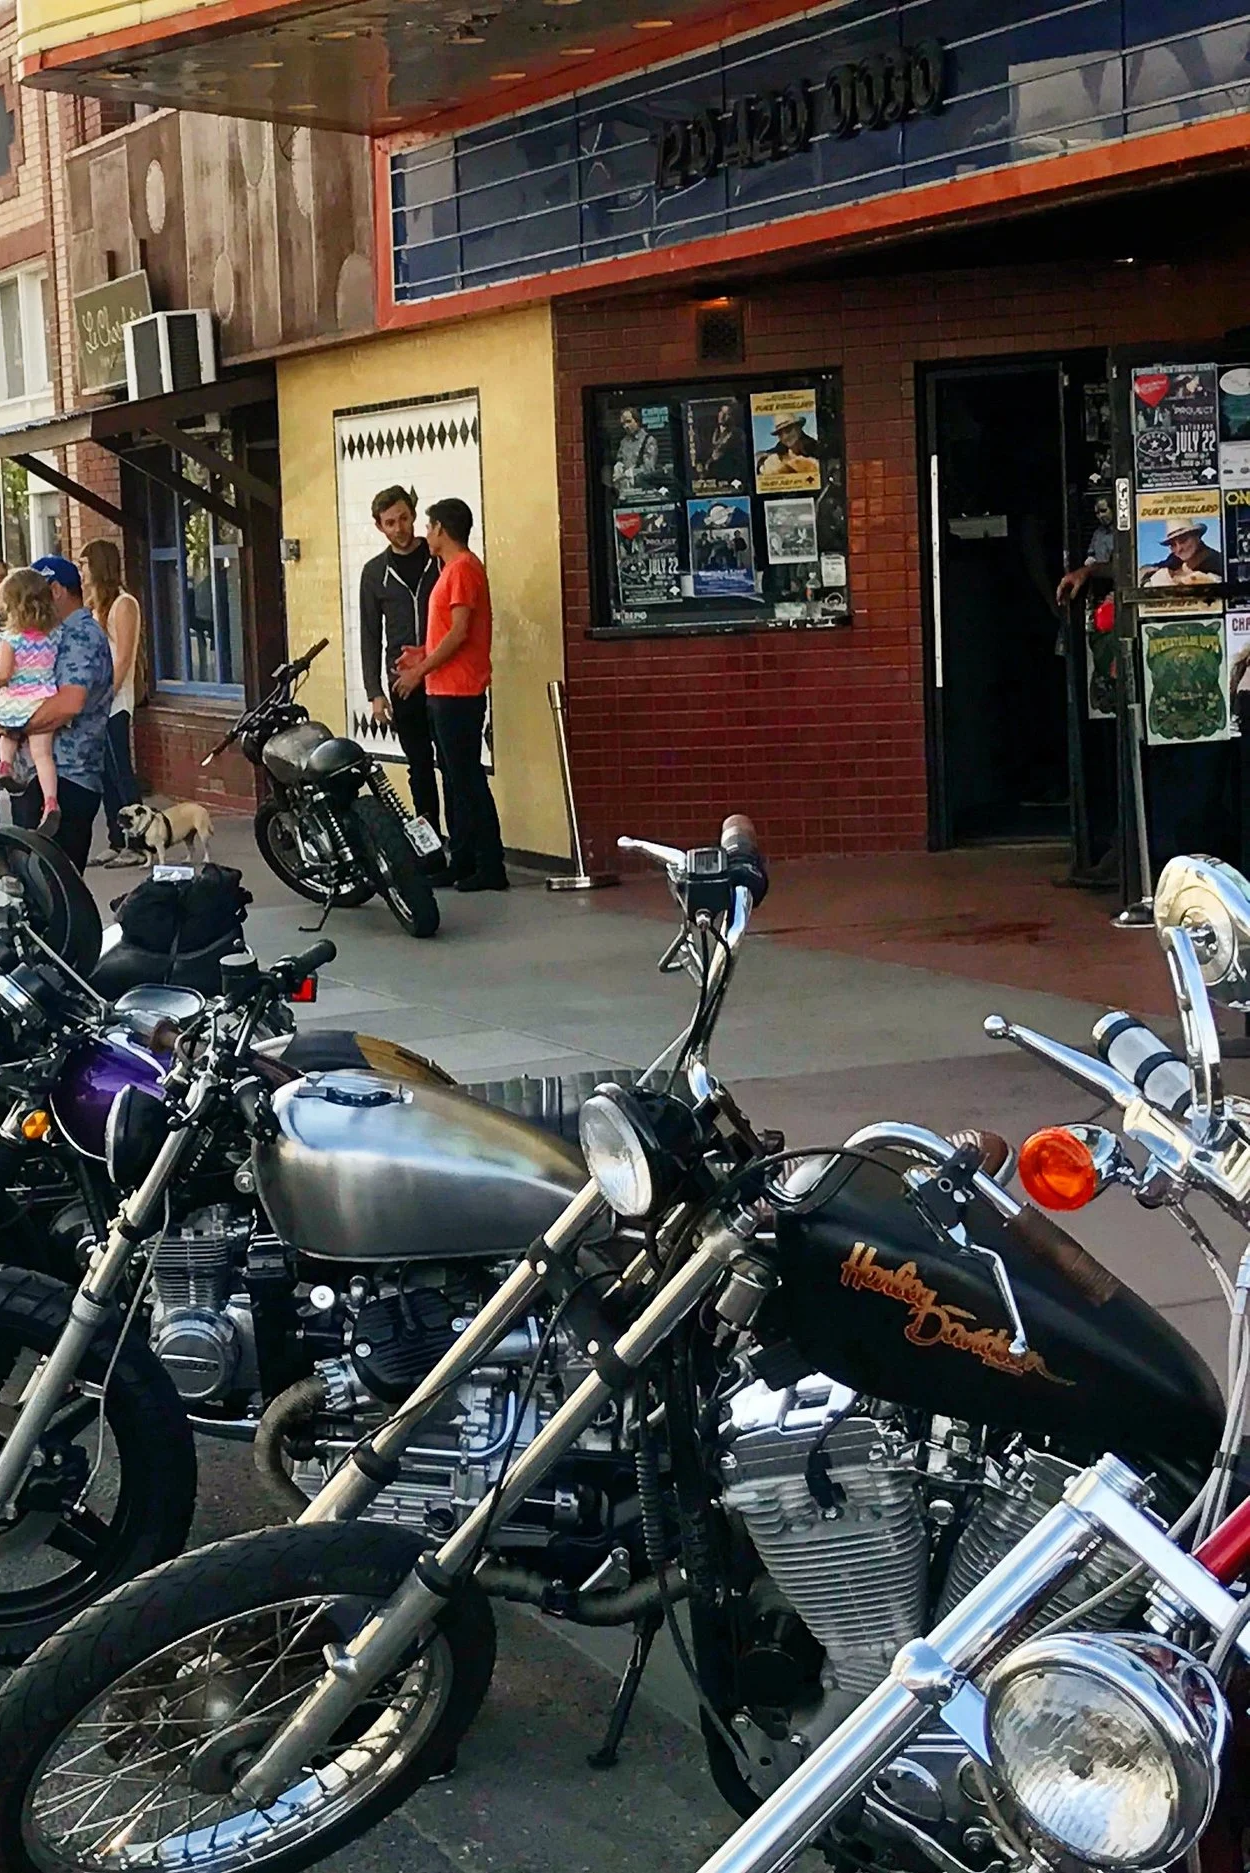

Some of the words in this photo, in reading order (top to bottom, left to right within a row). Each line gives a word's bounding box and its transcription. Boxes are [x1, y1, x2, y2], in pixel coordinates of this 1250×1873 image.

[1171, 431, 1200, 458] JULY
[1202, 430, 1216, 452] 22
[668, 557, 679, 574] 22
